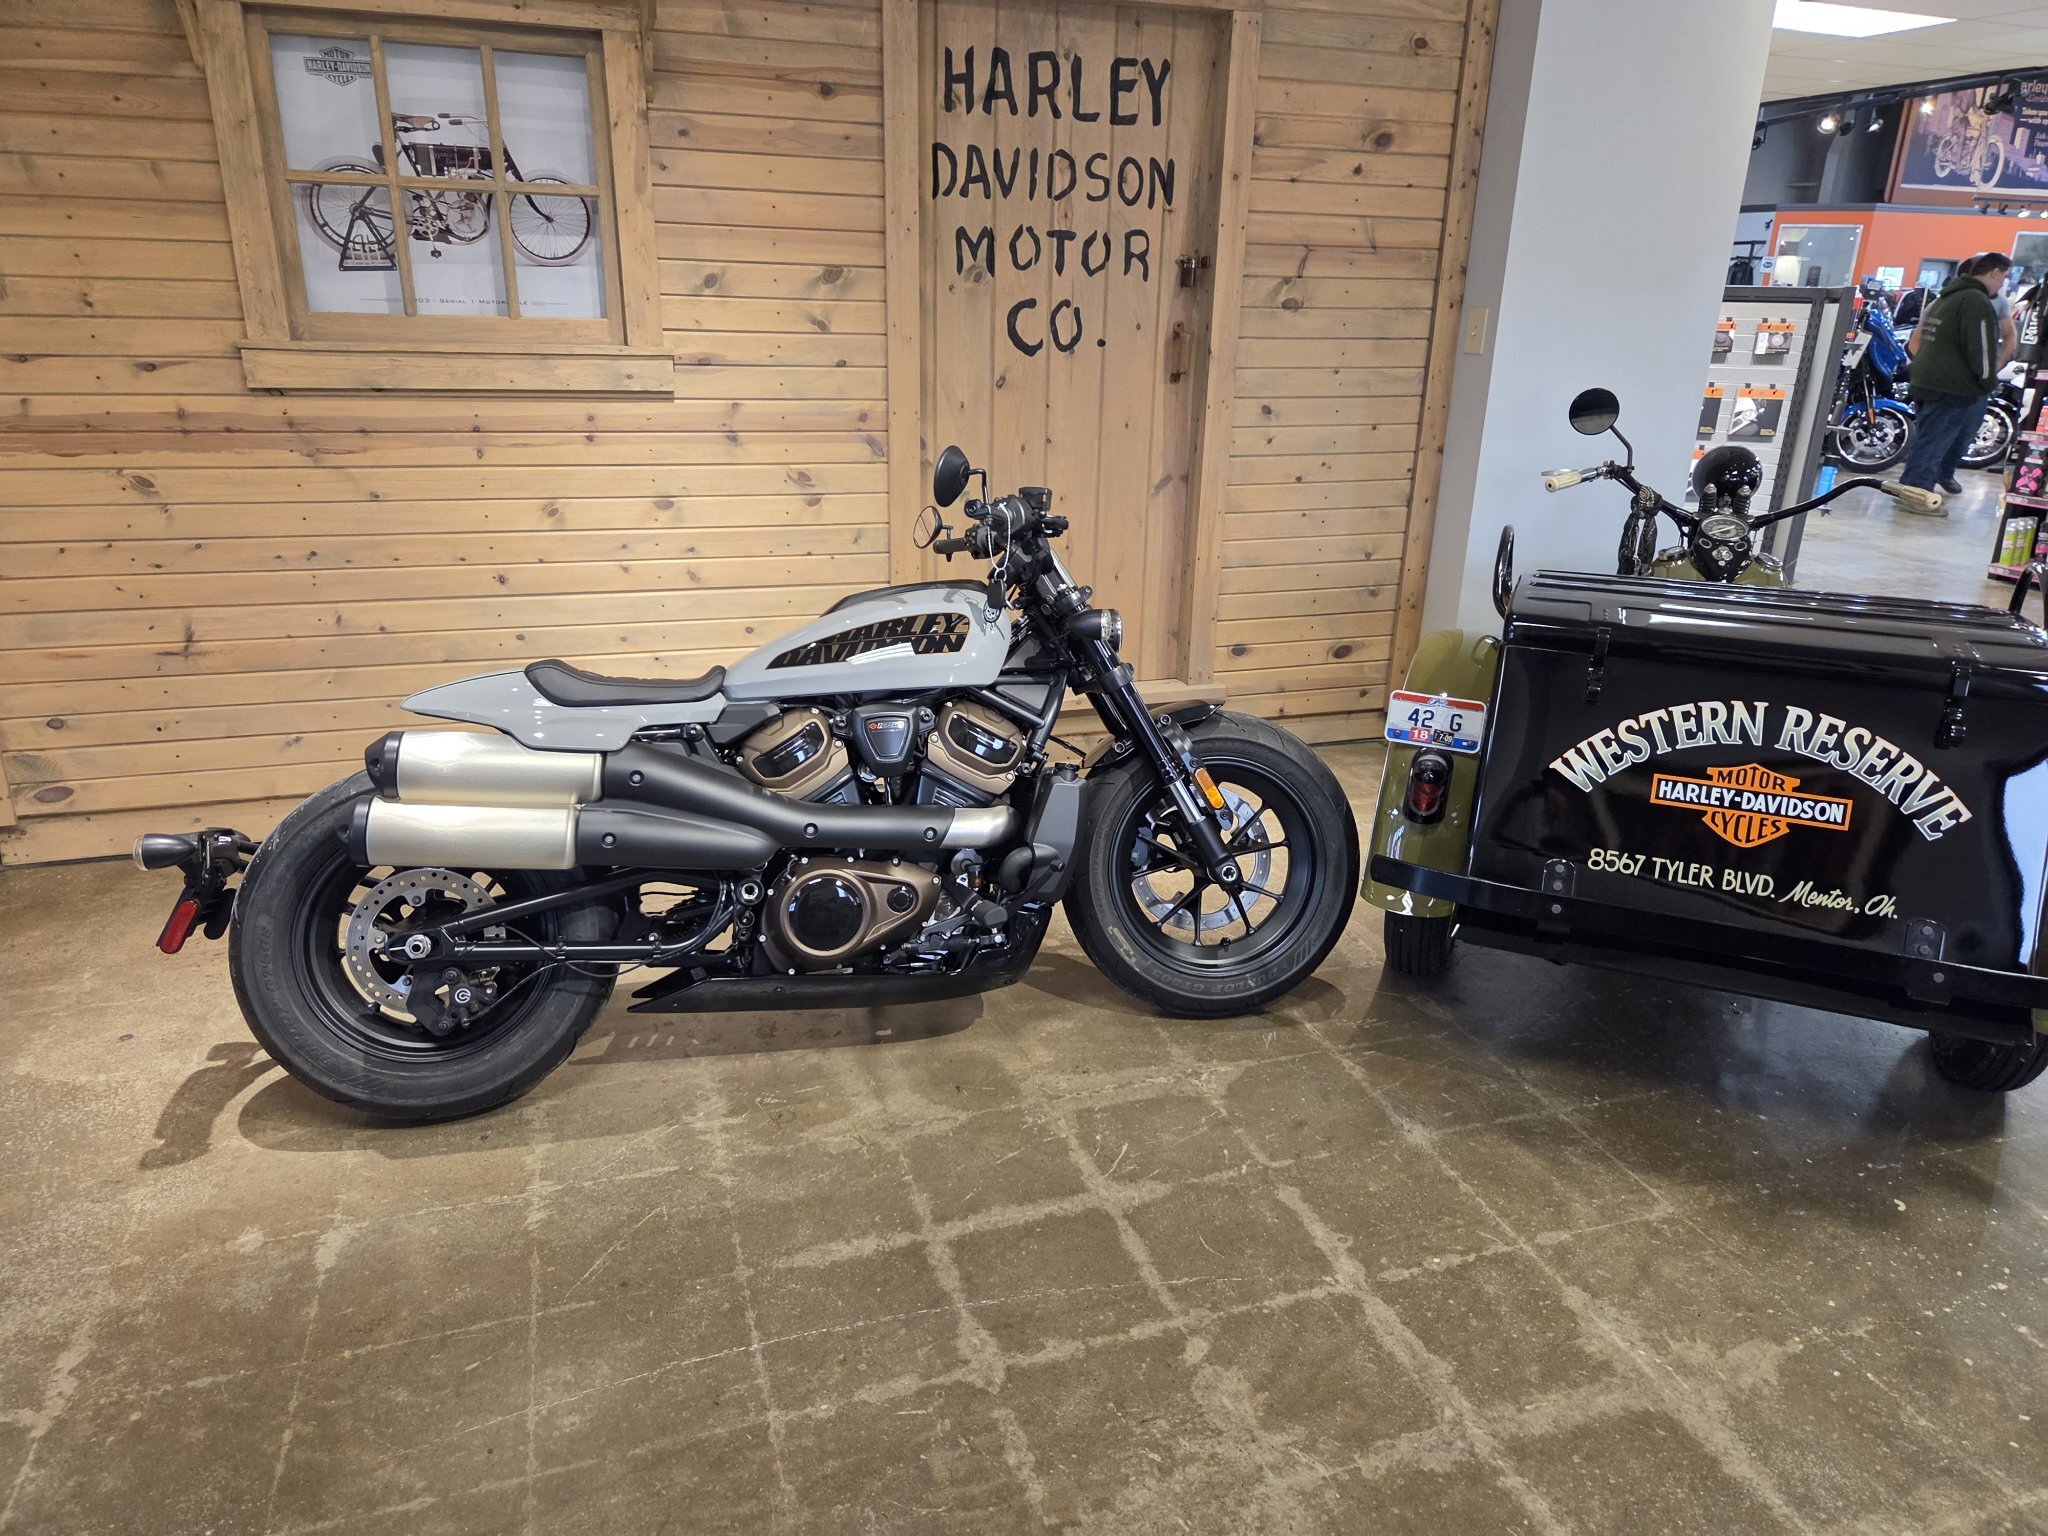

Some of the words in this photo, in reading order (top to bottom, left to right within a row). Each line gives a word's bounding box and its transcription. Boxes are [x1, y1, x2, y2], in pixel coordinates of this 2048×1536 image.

[321, 48, 351, 59] MOTOR
[944, 45, 1171, 127] HARLEY
[932, 142, 1175, 209] DAVIDSON
[955, 223, 1150, 282] MOTOR
[1006, 297, 1107, 357] CO.
[766, 633, 967, 670] DAVIDON
[1408, 708, 1435, 728] 42
[1449, 713, 1463, 732] G
[1411, 729, 1429, 741] 18
[1549, 700, 1769, 793] WESTERN
[1774, 705, 1973, 841] RESERVE
[1716, 766, 1786, 791] MOTOR
[1658, 780, 1845, 824] HARLEY-DAVIDSON
[1711, 811, 1783, 843] CYCLES
[1587, 848, 1646, 876] 8567
[1651, 856, 1715, 888] TYLER
[1721, 869, 1775, 898] BLVD.
[1778, 880, 1860, 914] Mentor,
[1864, 894, 1899, 919] Oh.
